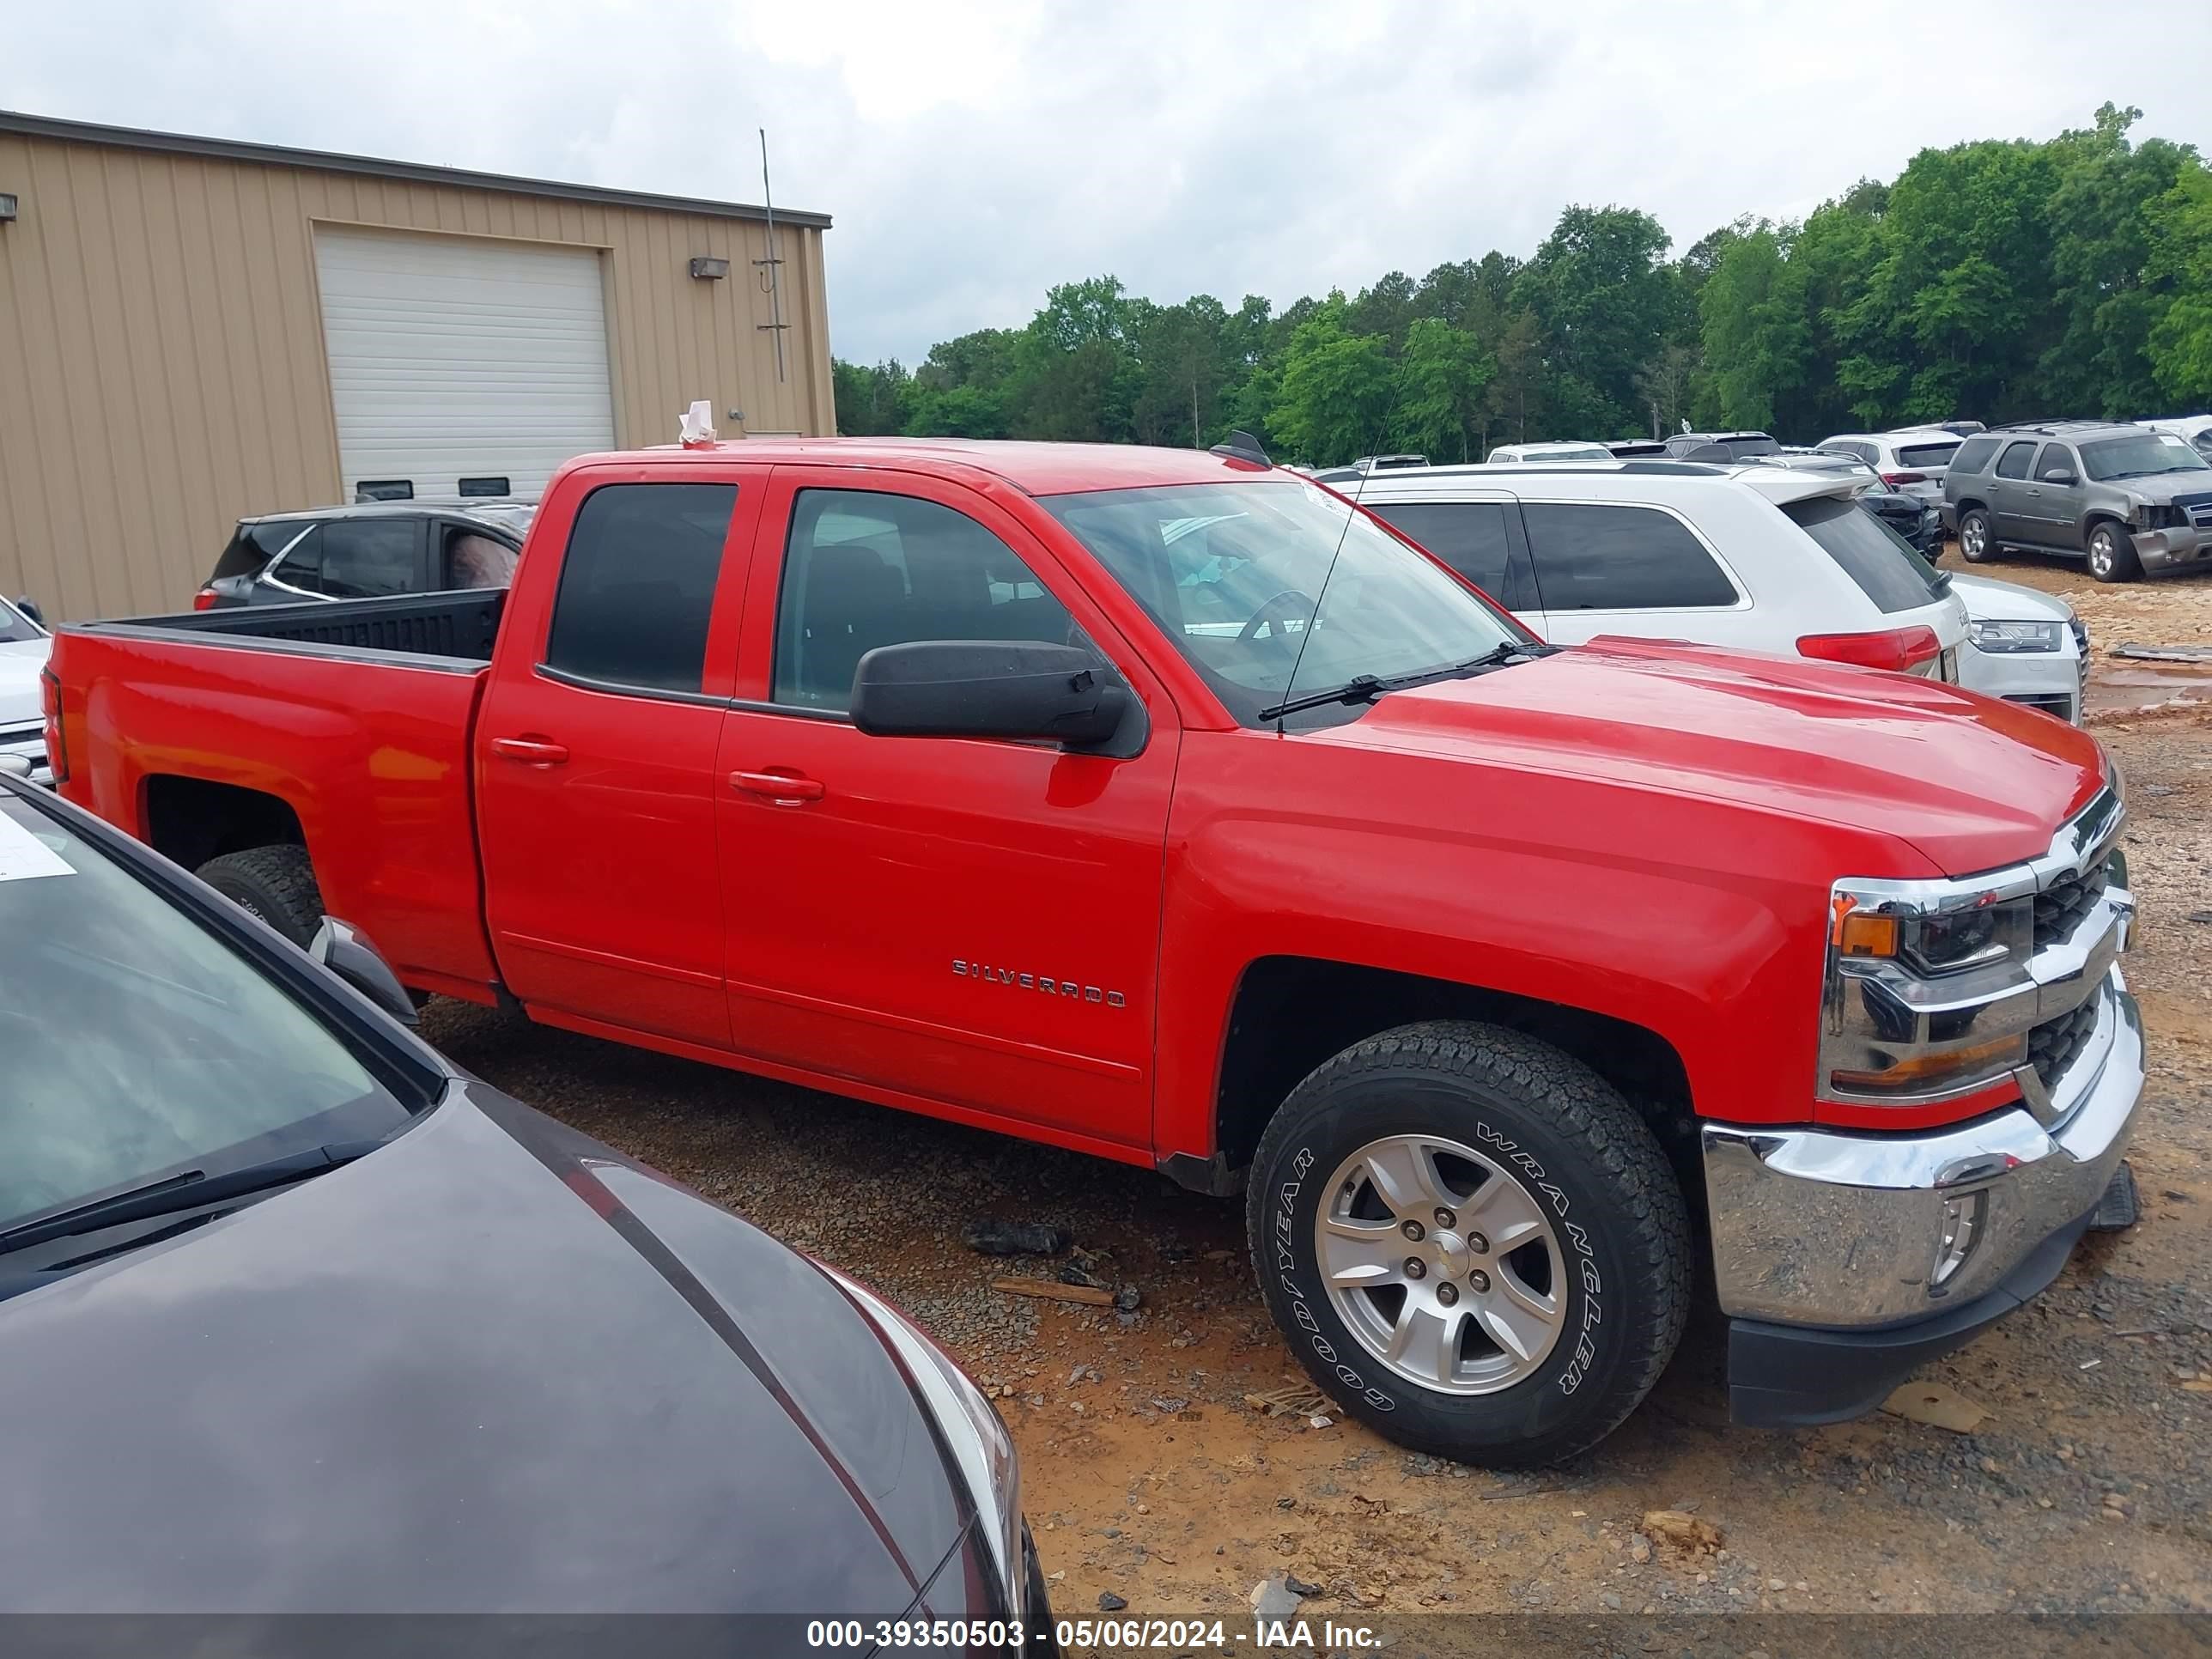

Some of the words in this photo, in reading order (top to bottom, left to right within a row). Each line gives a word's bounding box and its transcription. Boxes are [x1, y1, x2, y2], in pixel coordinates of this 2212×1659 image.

[952, 959, 1127, 1007] SILVERADO
[1276, 1147, 1395, 1411] GOODYEAR
[1477, 1121, 1601, 1395] WRANGLER
